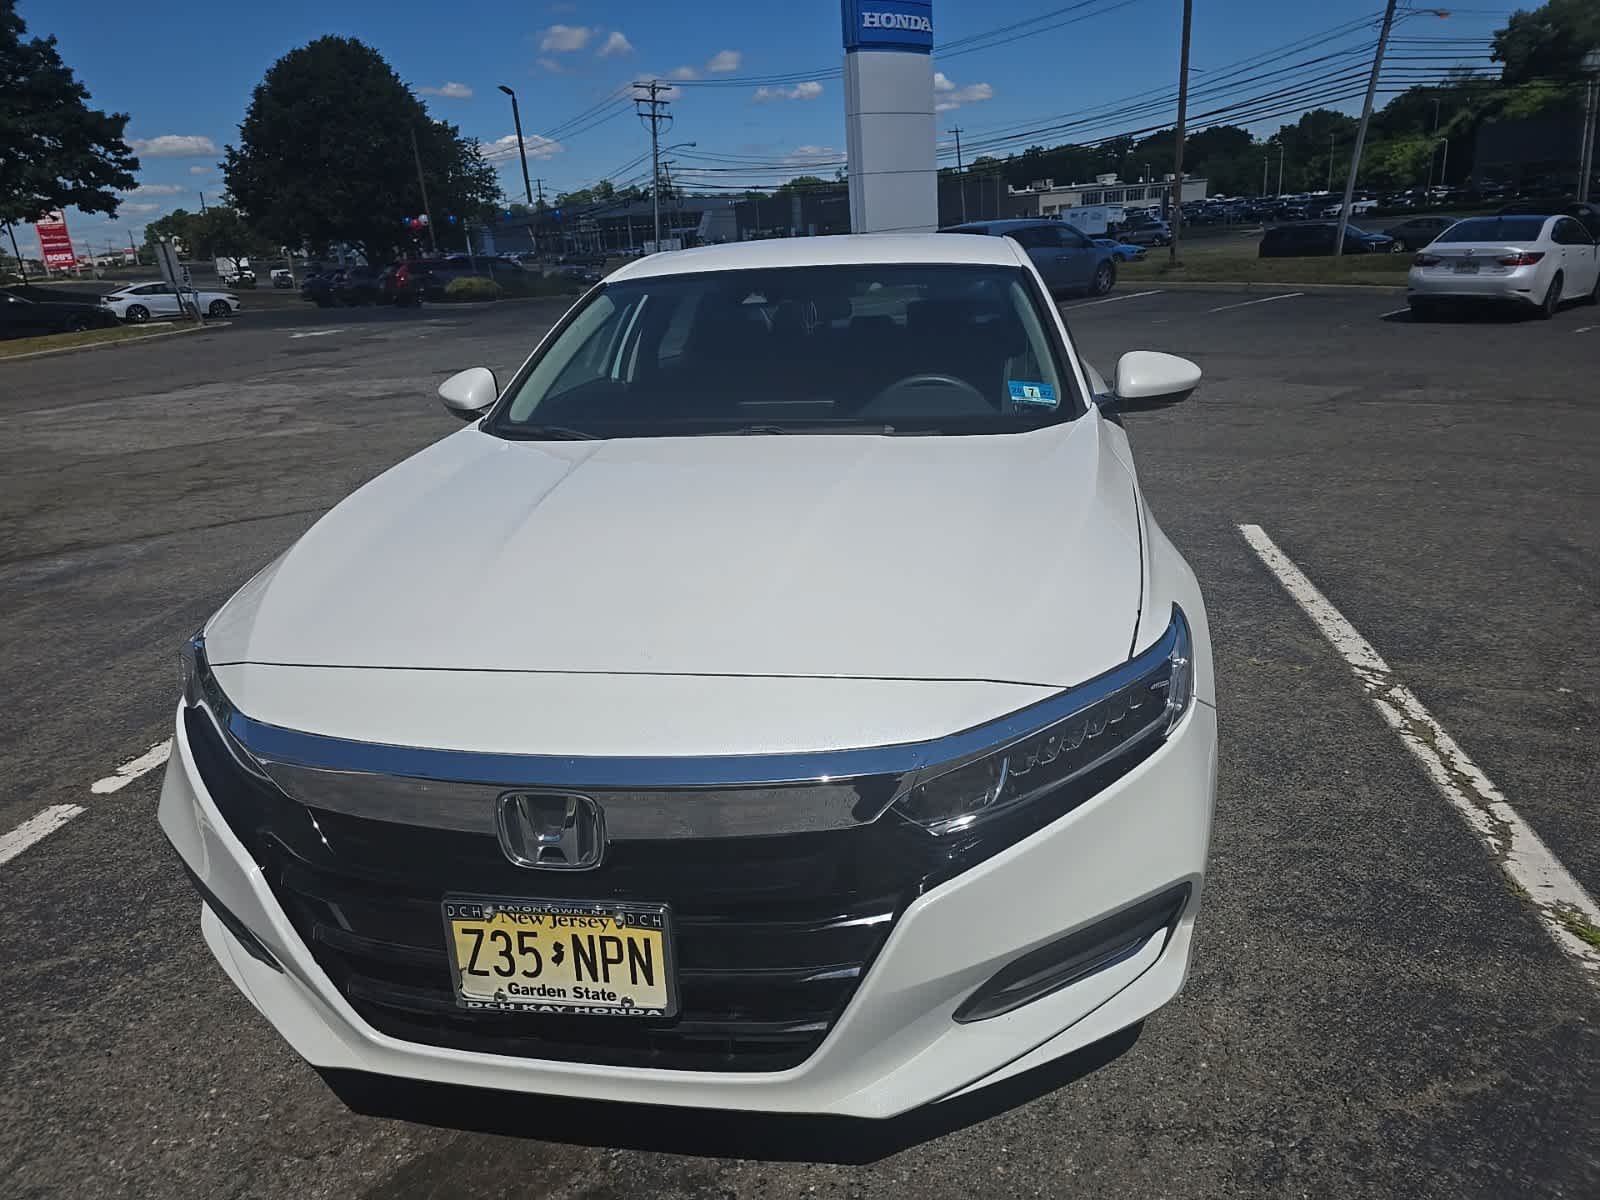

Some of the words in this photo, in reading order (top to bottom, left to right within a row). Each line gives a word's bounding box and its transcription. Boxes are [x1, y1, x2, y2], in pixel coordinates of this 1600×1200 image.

[862, 12, 933, 32] HONDA
[500, 911, 546, 926] New
[549, 913, 610, 933] Jersey
[627, 914, 662, 927] DCH
[461, 928, 543, 978] Z35
[571, 933, 655, 987] NPN
[507, 983, 567, 998] Garden
[573, 986, 617, 1001] State
[467, 1001, 515, 1010] DCH
[523, 1003, 567, 1013] KAY
[574, 1007, 663, 1017] HONDA
